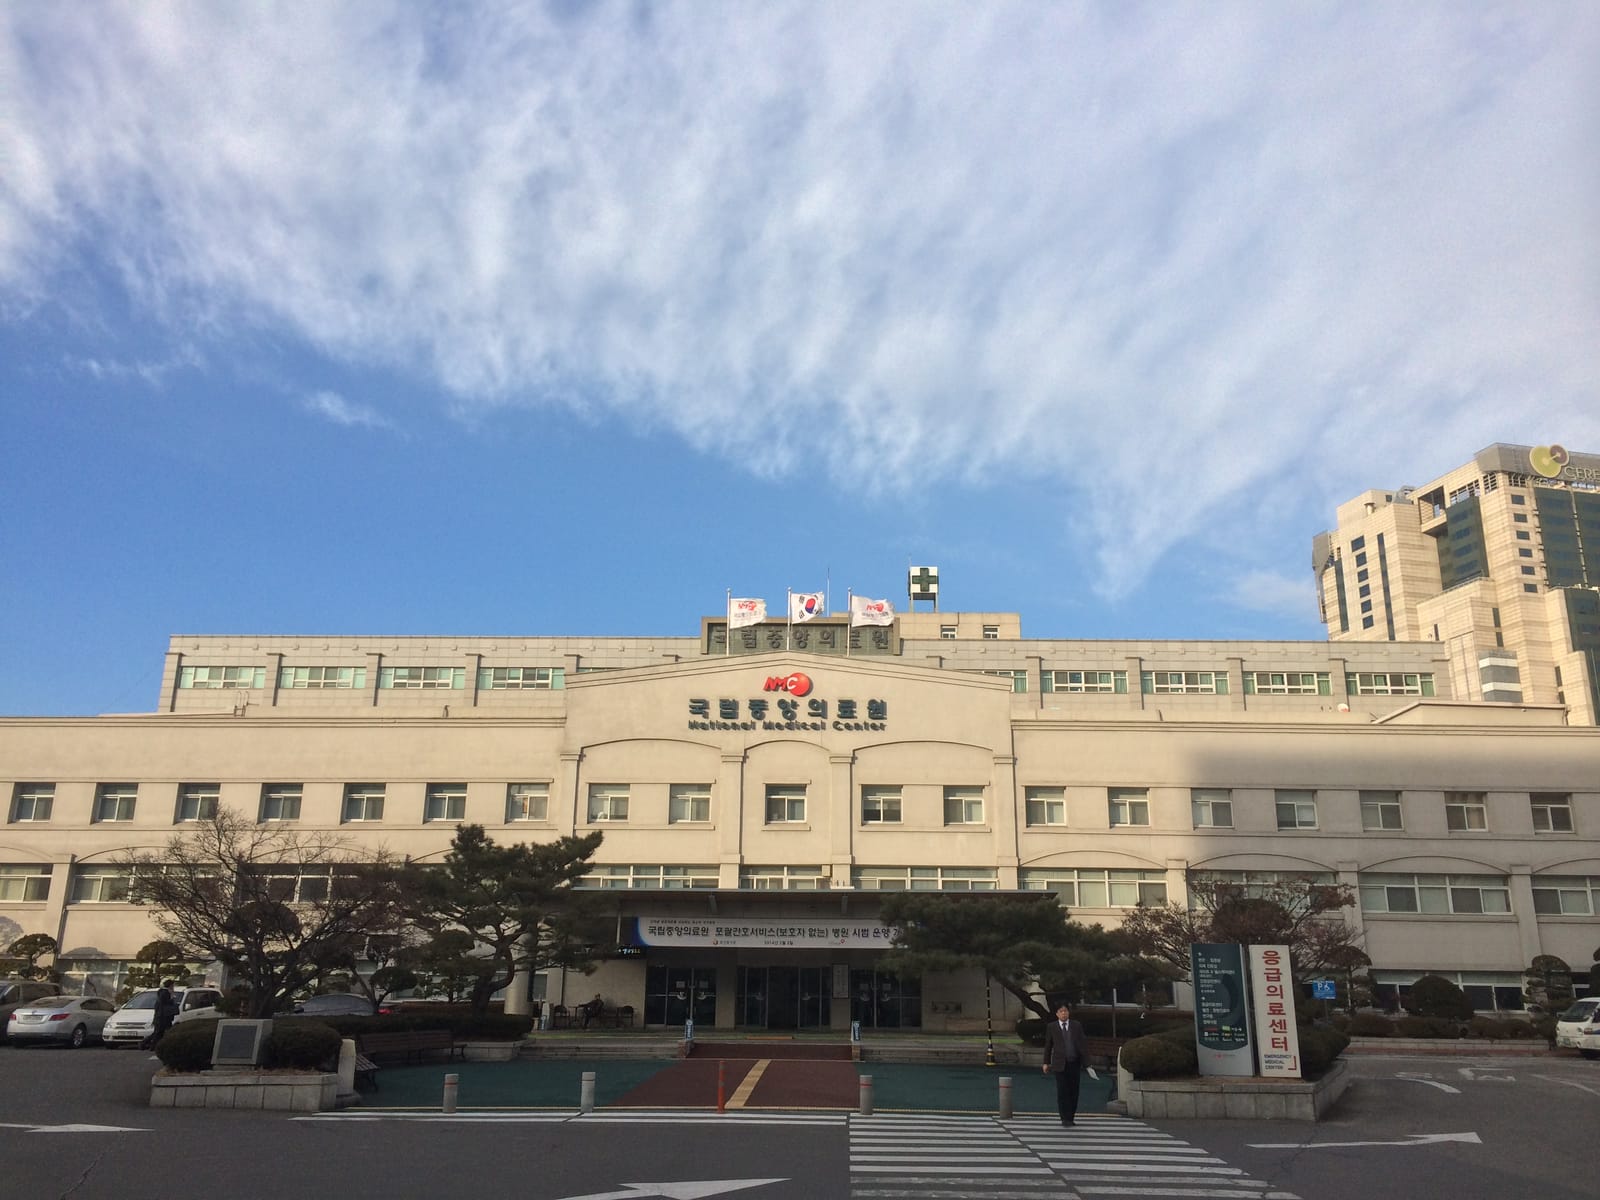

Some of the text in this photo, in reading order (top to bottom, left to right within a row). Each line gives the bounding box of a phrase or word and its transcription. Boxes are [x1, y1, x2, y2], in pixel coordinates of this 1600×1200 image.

[688, 698, 887, 721] 국립중앙의료원
[688, 720, 887, 731] National Medical Center
[648, 926, 709, 937] 국립중앙의료원
[832, 927, 849, 938] 병원
[852, 927, 870, 938] 시범
[1262, 950, 1288, 1052] 응급의료센터
